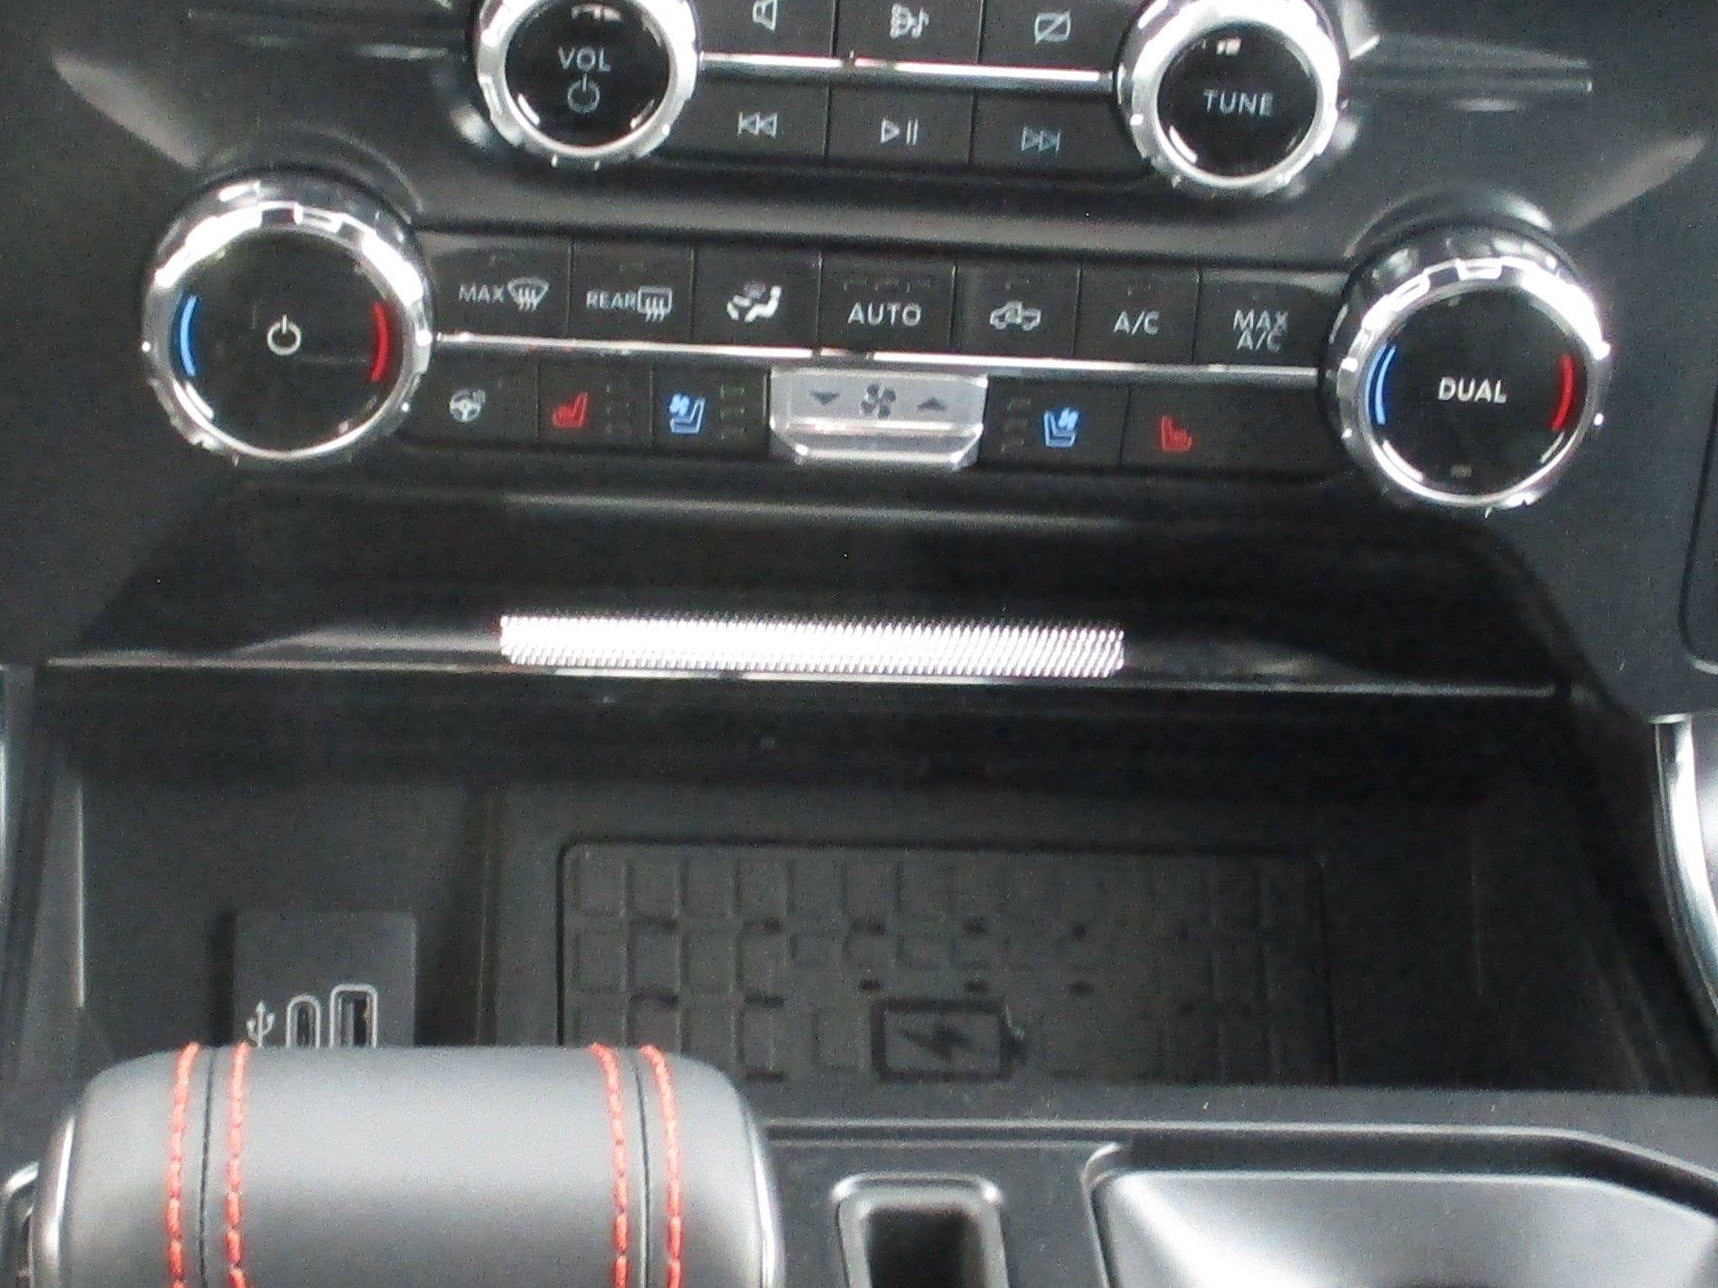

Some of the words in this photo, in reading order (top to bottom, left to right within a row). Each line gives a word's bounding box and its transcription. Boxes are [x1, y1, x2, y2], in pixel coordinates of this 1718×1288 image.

[558, 45, 611, 72] VOL
[1204, 89, 1273, 117] TUNE
[459, 283, 505, 303] MAX
[586, 289, 637, 310] REAR
[847, 301, 923, 328] AUTO
[1113, 310, 1160, 336] A/C
[1232, 309, 1289, 333] MAX
[1236, 328, 1285, 354] A/C
[1438, 376, 1508, 404] DUAL
